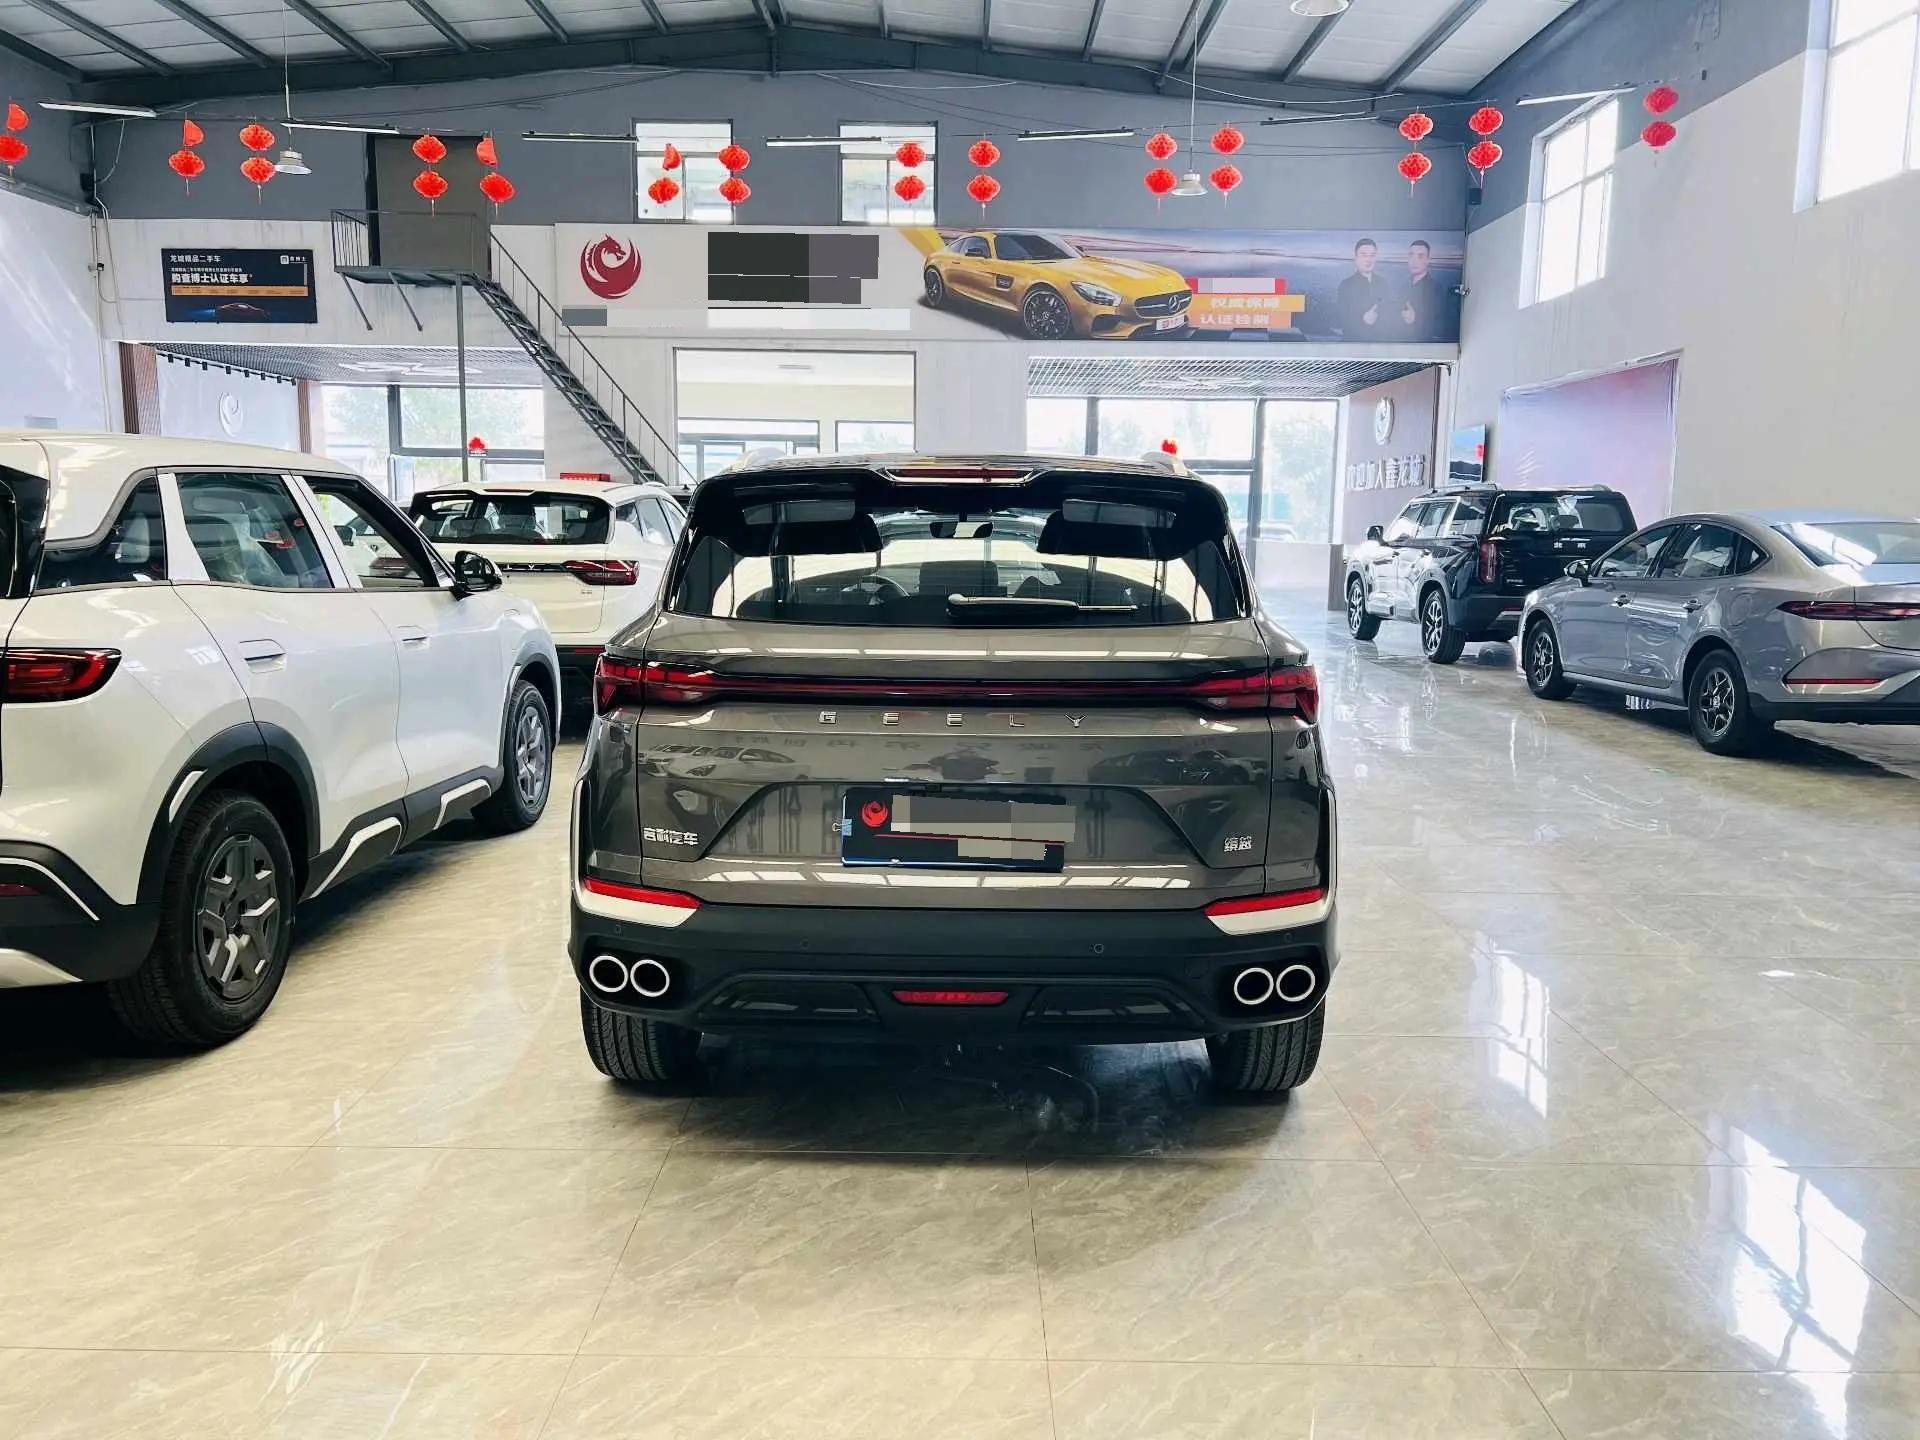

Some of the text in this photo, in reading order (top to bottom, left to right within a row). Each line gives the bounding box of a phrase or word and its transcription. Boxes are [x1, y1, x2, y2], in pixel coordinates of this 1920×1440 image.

[818, 711, 1087, 728] GEELY
[643, 827, 699, 846] 吉利汽车
